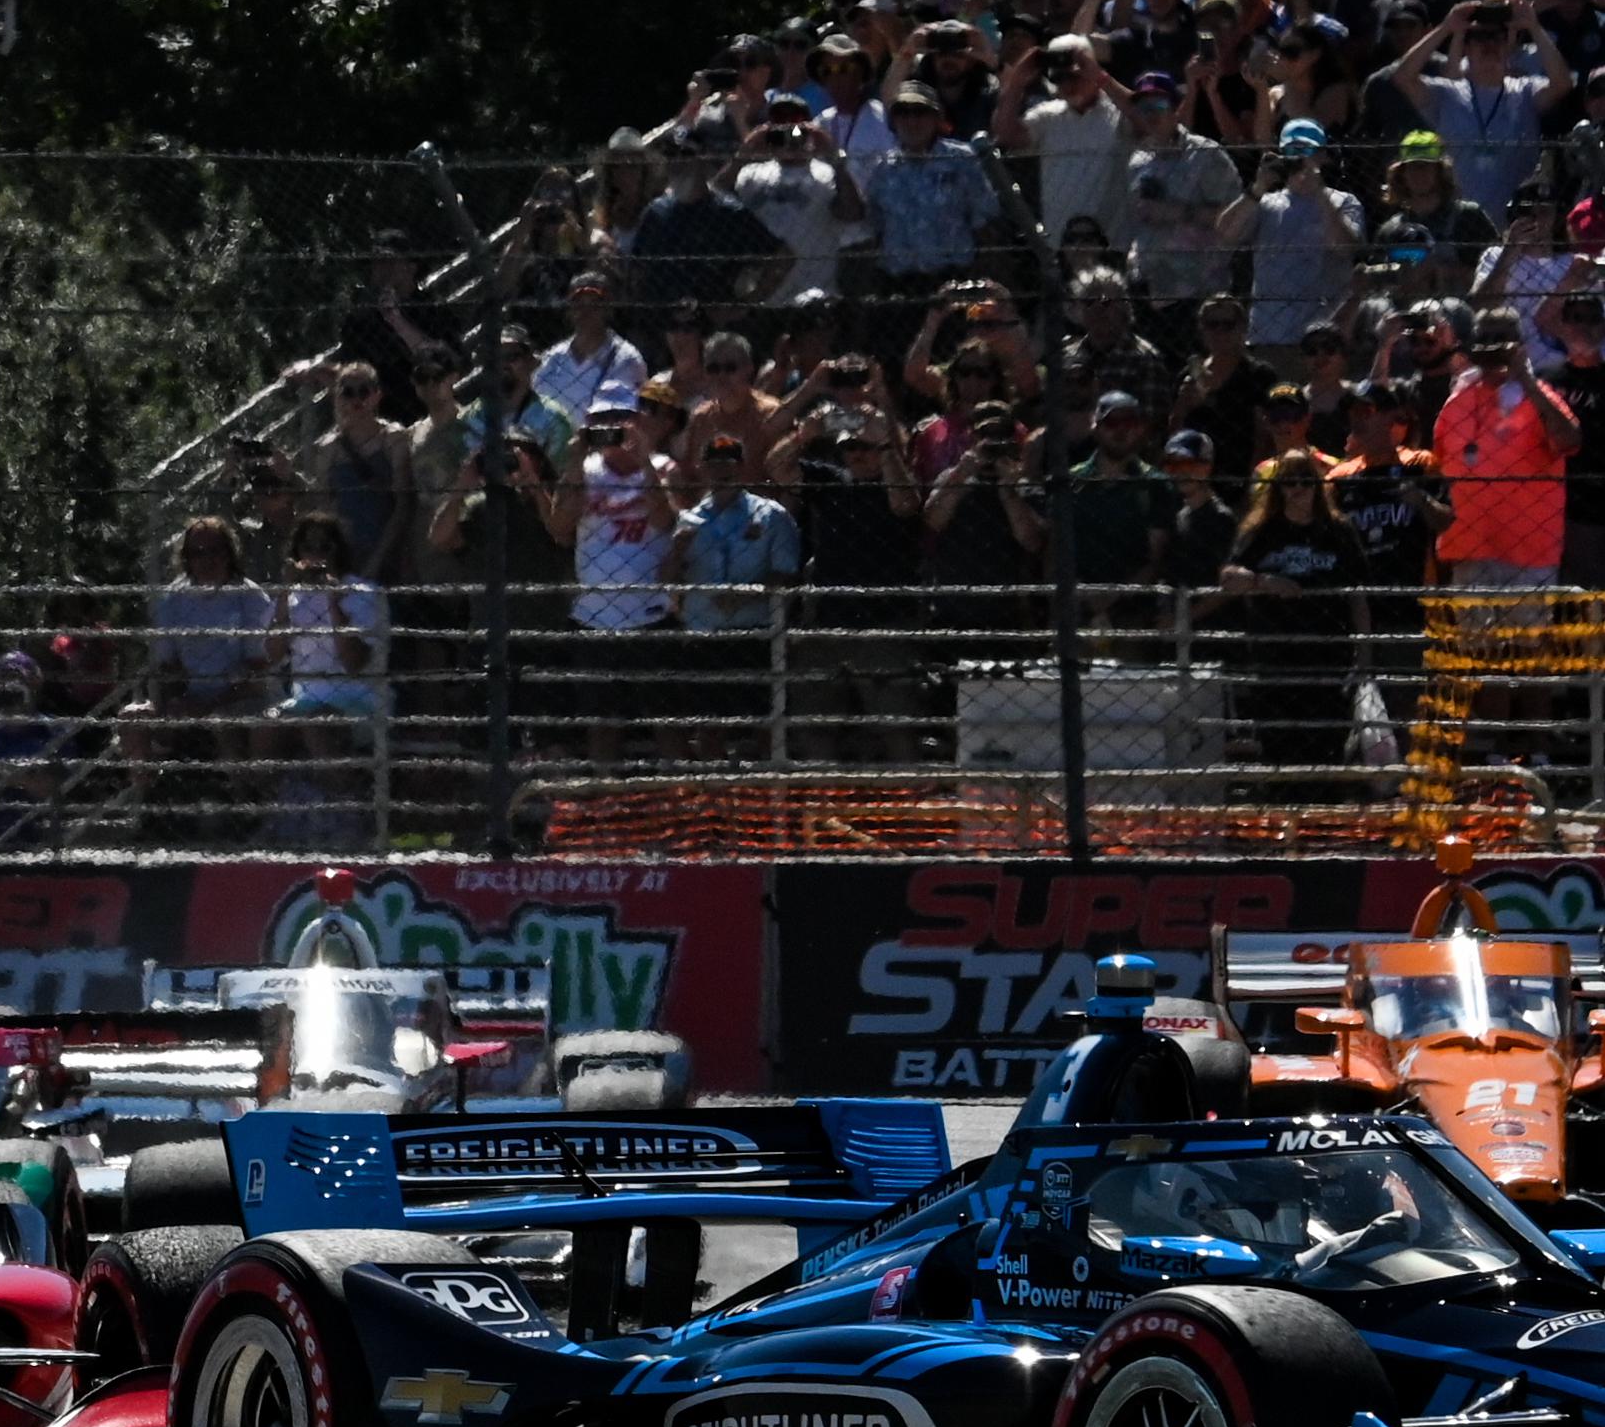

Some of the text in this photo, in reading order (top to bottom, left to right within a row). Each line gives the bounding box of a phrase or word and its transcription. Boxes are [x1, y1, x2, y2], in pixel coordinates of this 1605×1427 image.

[900, 863, 1294, 950] SUPER
[290, 891, 654, 1031] O'Rlly
[1144, 1016, 1211, 1032] ONAX
[1464, 1079, 1538, 1109] 21
[1277, 1124, 1455, 1154] MCLAUGH
[405, 1138, 718, 1175] FREIGHTLINER
[801, 1228, 871, 1284] PENSKE
[996, 1253, 1030, 1275] Shell
[1121, 1243, 1211, 1275] Mazak
[996, 1278, 1083, 1310] V-Power
